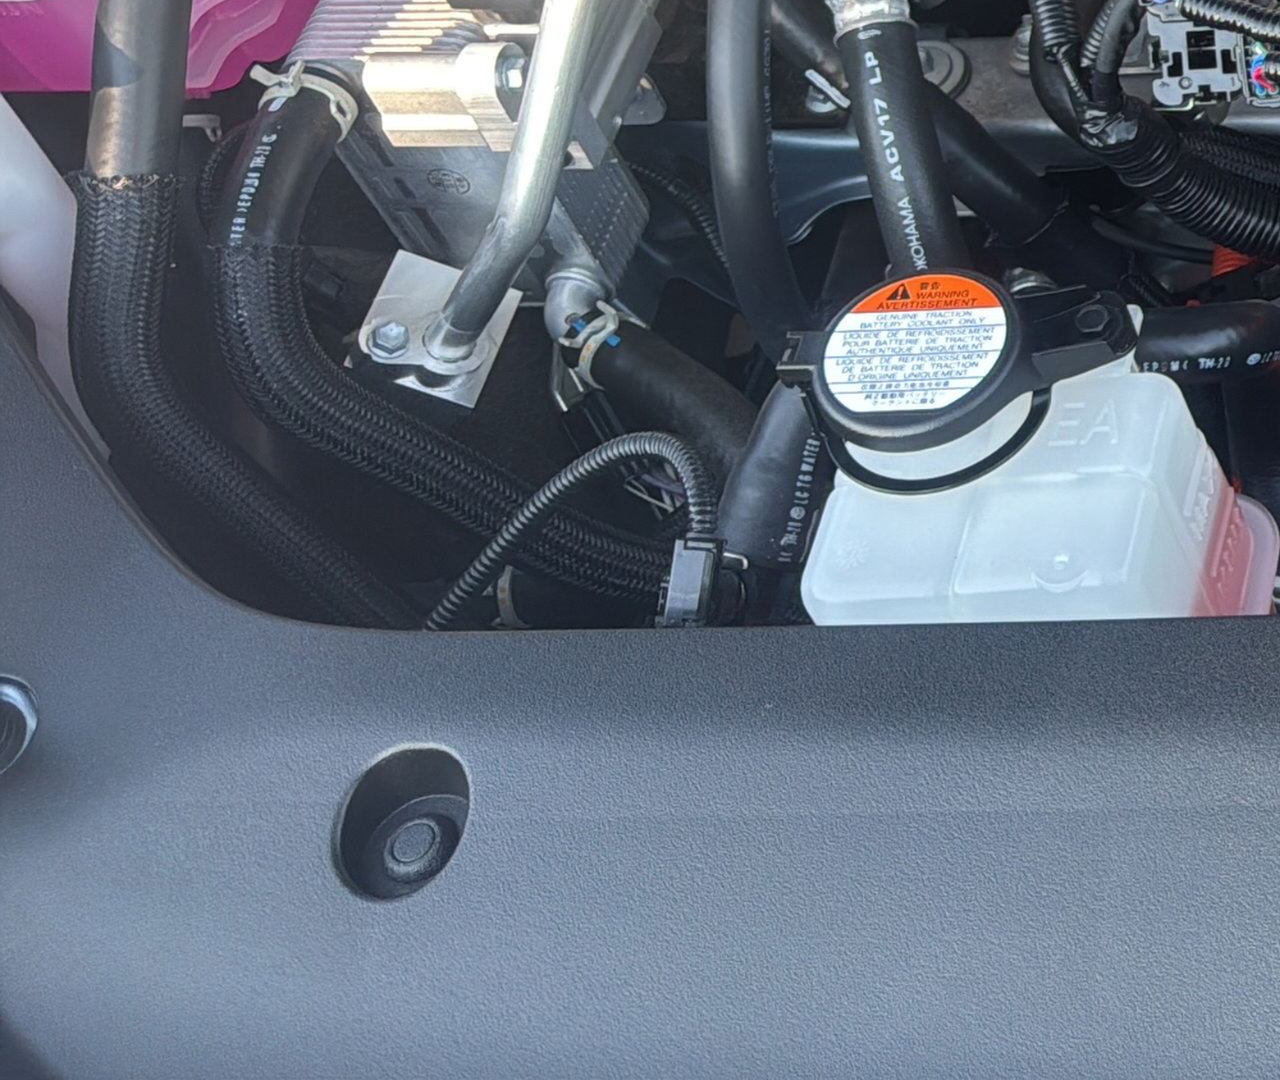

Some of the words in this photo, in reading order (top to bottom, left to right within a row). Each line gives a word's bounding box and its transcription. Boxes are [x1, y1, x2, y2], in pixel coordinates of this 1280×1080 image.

[864, 51, 883, 86] LP
[873, 97, 905, 182] ACV17
[916, 290, 970, 299] WARNING
[877, 298, 978, 310] AVERTISSEMENT
[876, 313, 918, 321] GENUINE
[908, 320, 953, 328] COOLANT
[843, 331, 879, 340] LIQUIDE
[905, 327, 995, 337] REFROIDISSEMENT
[842, 339, 870, 347] POUR
[875, 338, 920, 347] BATTERIE
[945, 335, 993, 343] TRACTION
[846, 346, 913, 355] AUTHENTIQUE
[919, 343, 984, 352] UNIQUEMENT
[835, 358, 873, 366] LIQUIDE
[880, 357, 892, 365] DE
[898, 353, 989, 363] REFROIDISSEMENT
[841, 366, 854, 374] DE
[860, 364, 906, 373] BATTERIE
[911, 363, 924, 371] DE
[931, 362, 979, 370] TRACTION
[903, 370, 968, 379] UNIQUEMENT
[1048, 398, 1119, 445] EA
[798, 437, 821, 473] WATER
